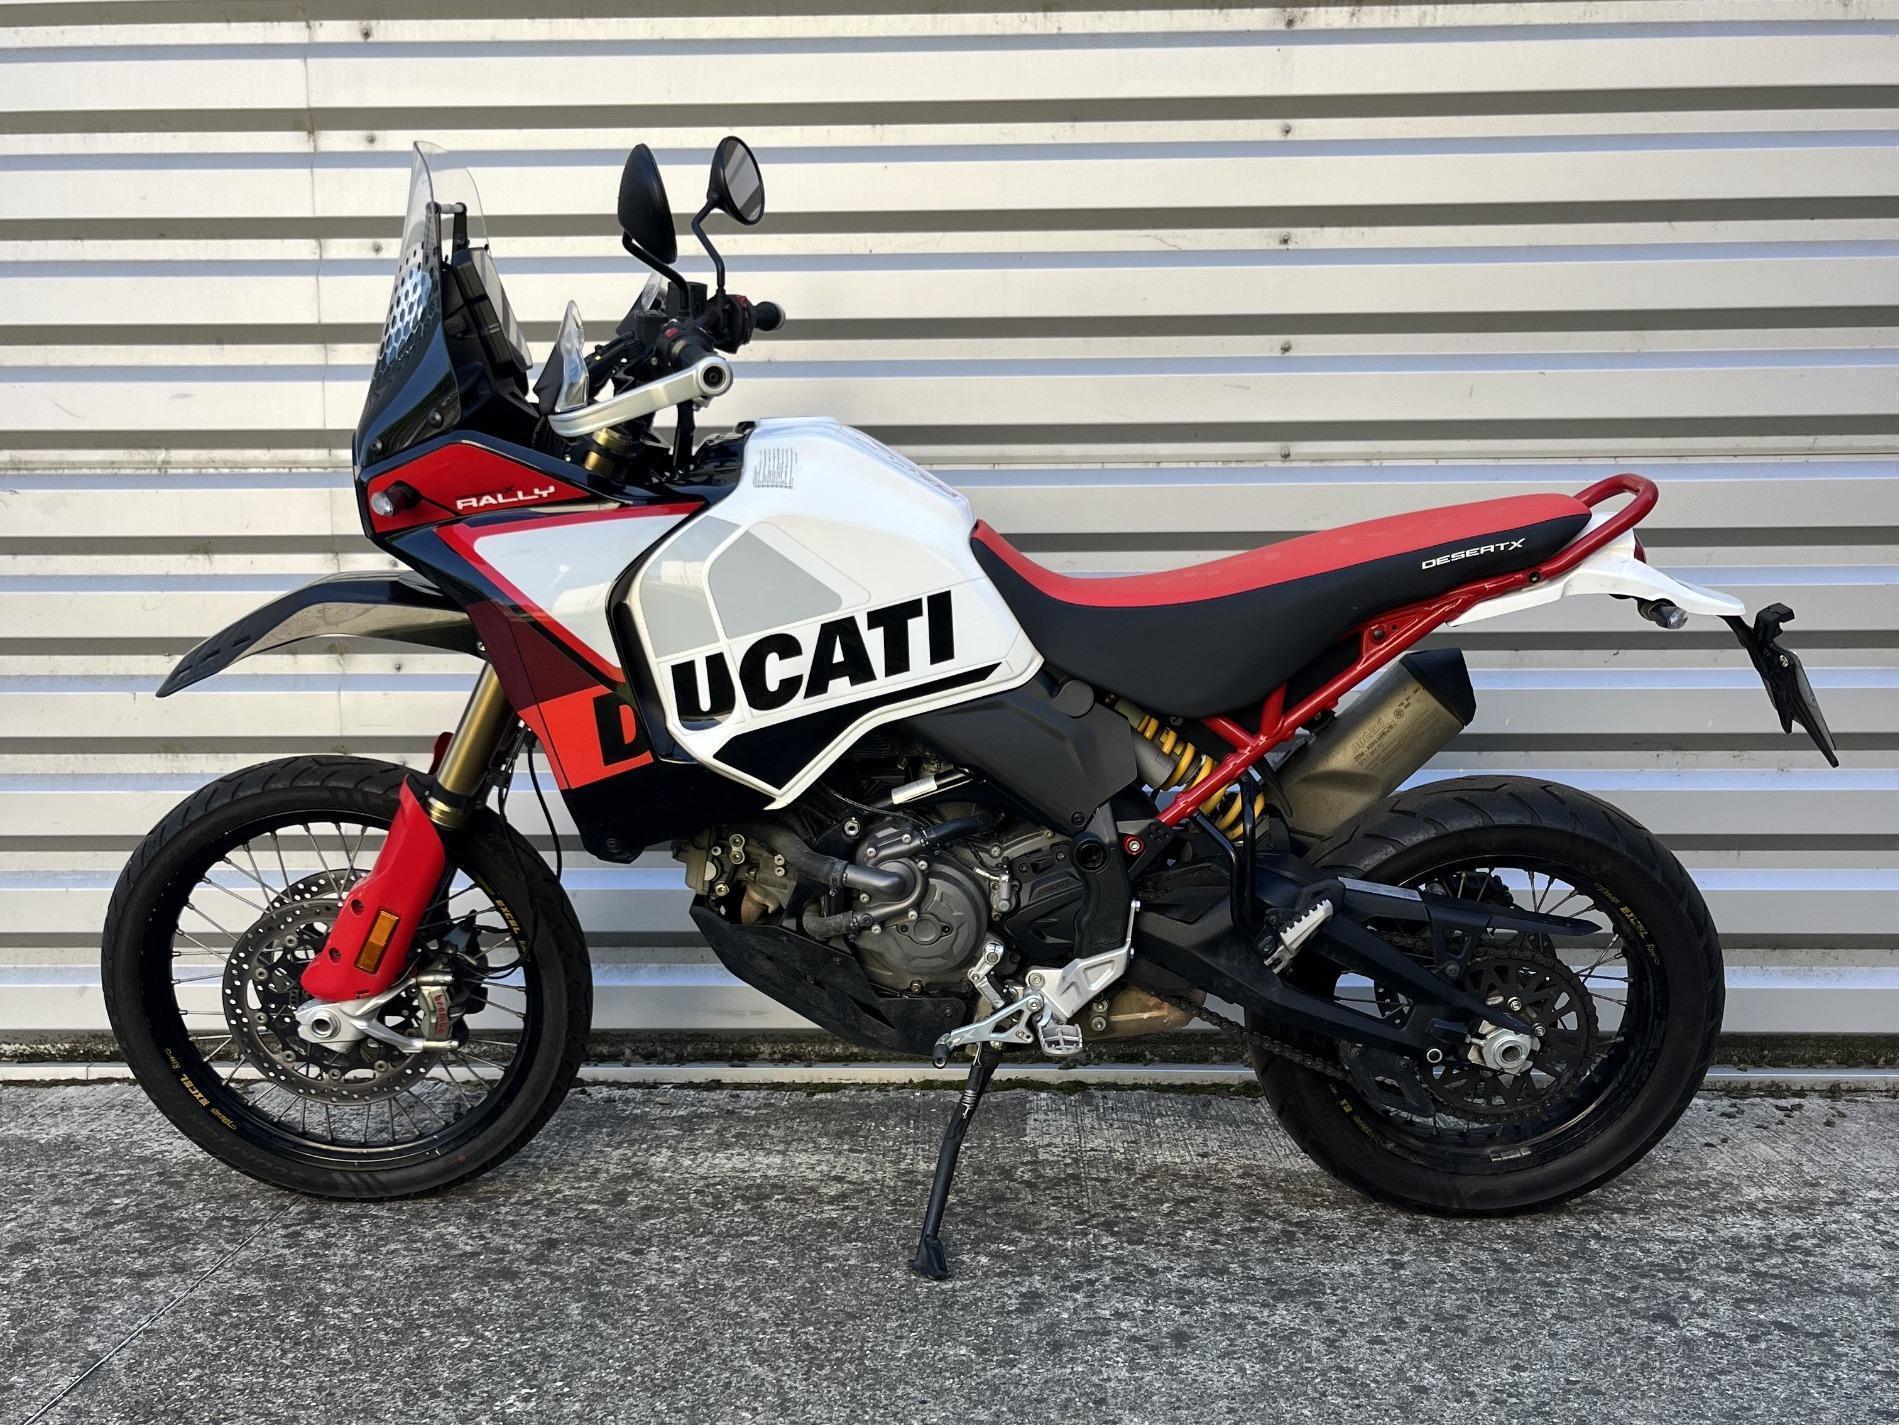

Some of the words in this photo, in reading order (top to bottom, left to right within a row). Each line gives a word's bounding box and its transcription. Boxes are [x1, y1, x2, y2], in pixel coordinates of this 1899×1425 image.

[456, 485, 556, 510] RALLY
[1421, 537, 1526, 570] DESERTX
[593, 590, 956, 767] DUCATI
[495, 899, 521, 935] EXCEL
[434, 994, 447, 1035] brembo
[180, 1073, 210, 1107] EXCEL
